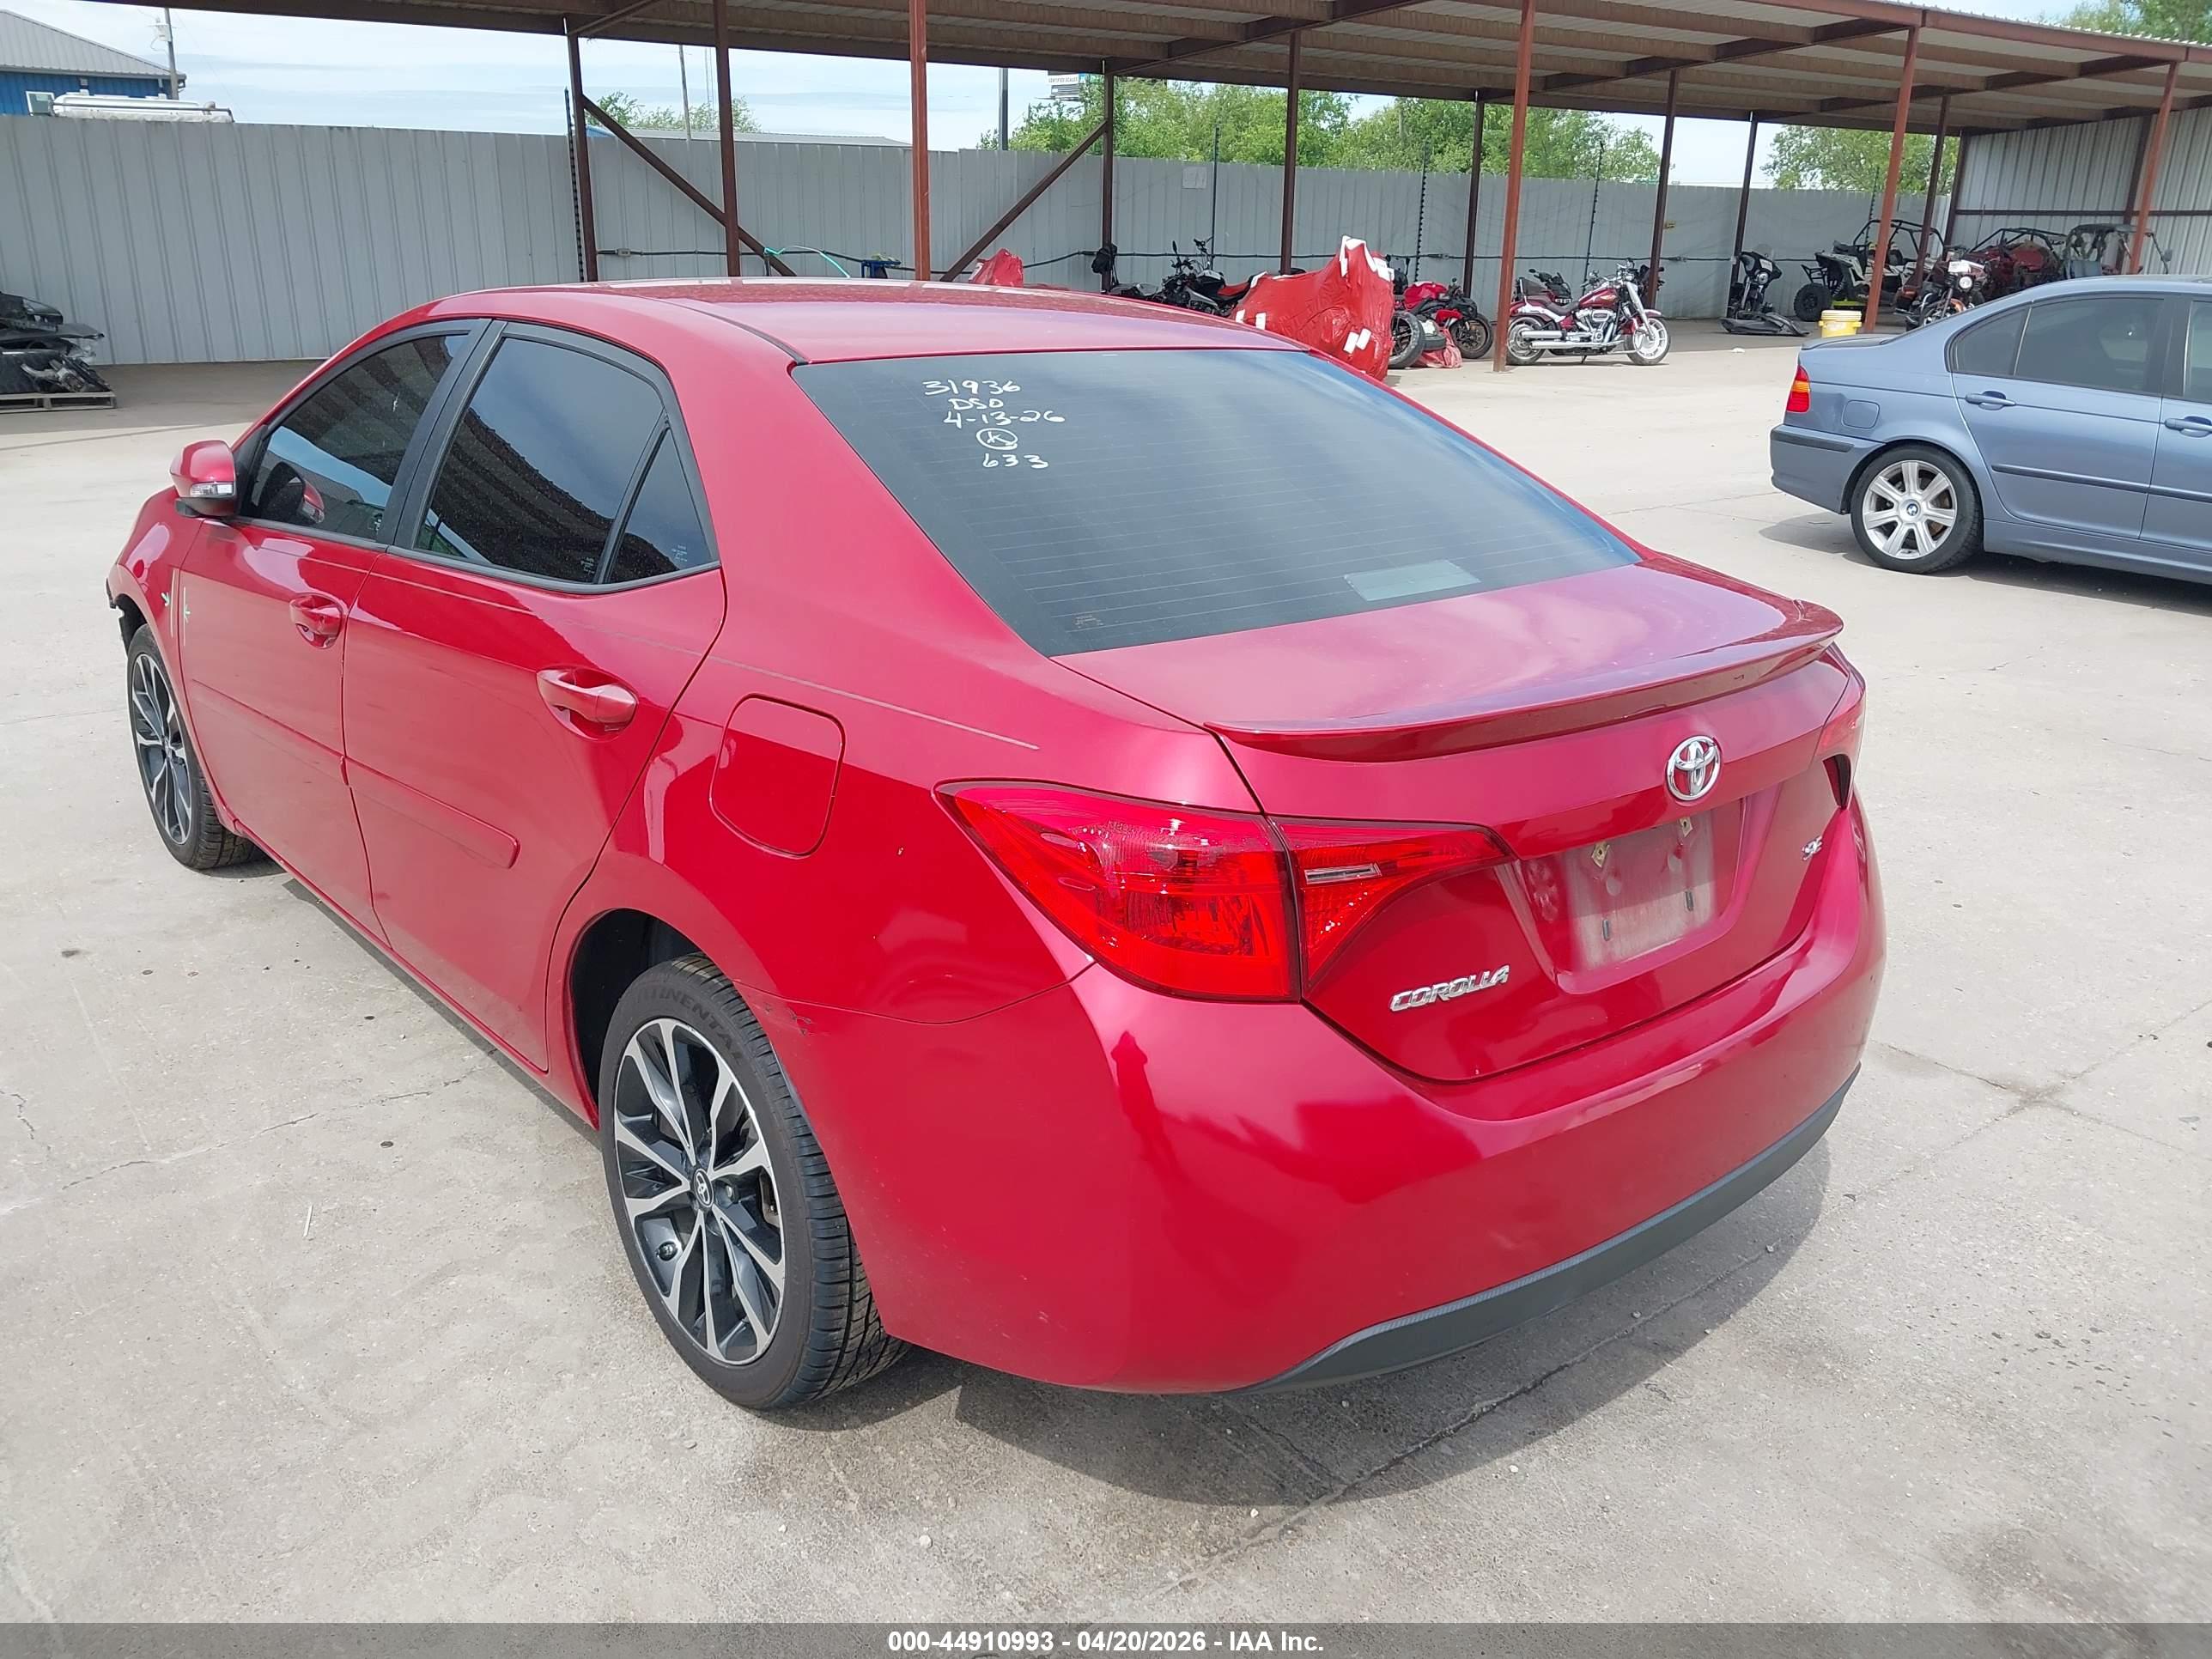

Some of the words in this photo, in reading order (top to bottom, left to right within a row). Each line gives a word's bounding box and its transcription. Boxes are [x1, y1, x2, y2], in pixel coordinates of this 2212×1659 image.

[922, 379, 1021, 395] 31936
[944, 410, 1066, 428] 4-13-26
[982, 453, 1049, 469] 633
[1389, 964, 1510, 1012] COROLLA
